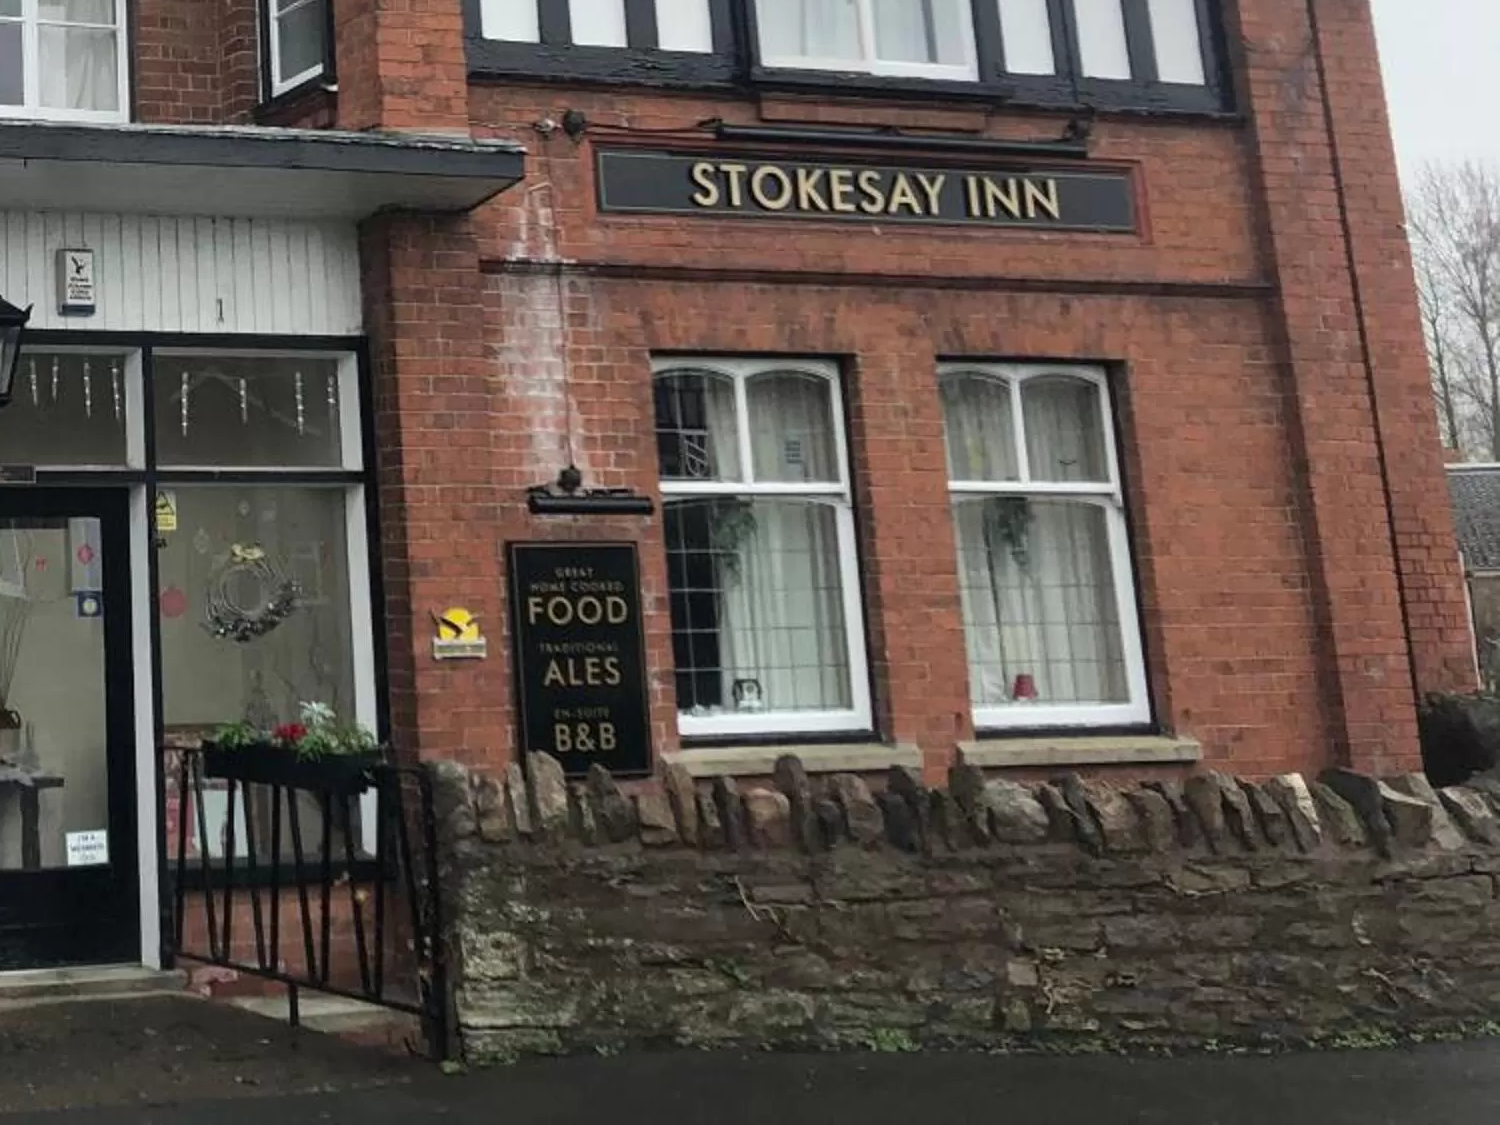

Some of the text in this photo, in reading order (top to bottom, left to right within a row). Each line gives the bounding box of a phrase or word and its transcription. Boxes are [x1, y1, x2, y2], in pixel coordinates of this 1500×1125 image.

[691, 161, 1061, 220] STOKESAY INN
[527, 595, 628, 625] FOOD
[543, 656, 622, 687] ALES
[554, 722, 617, 752] B&B
